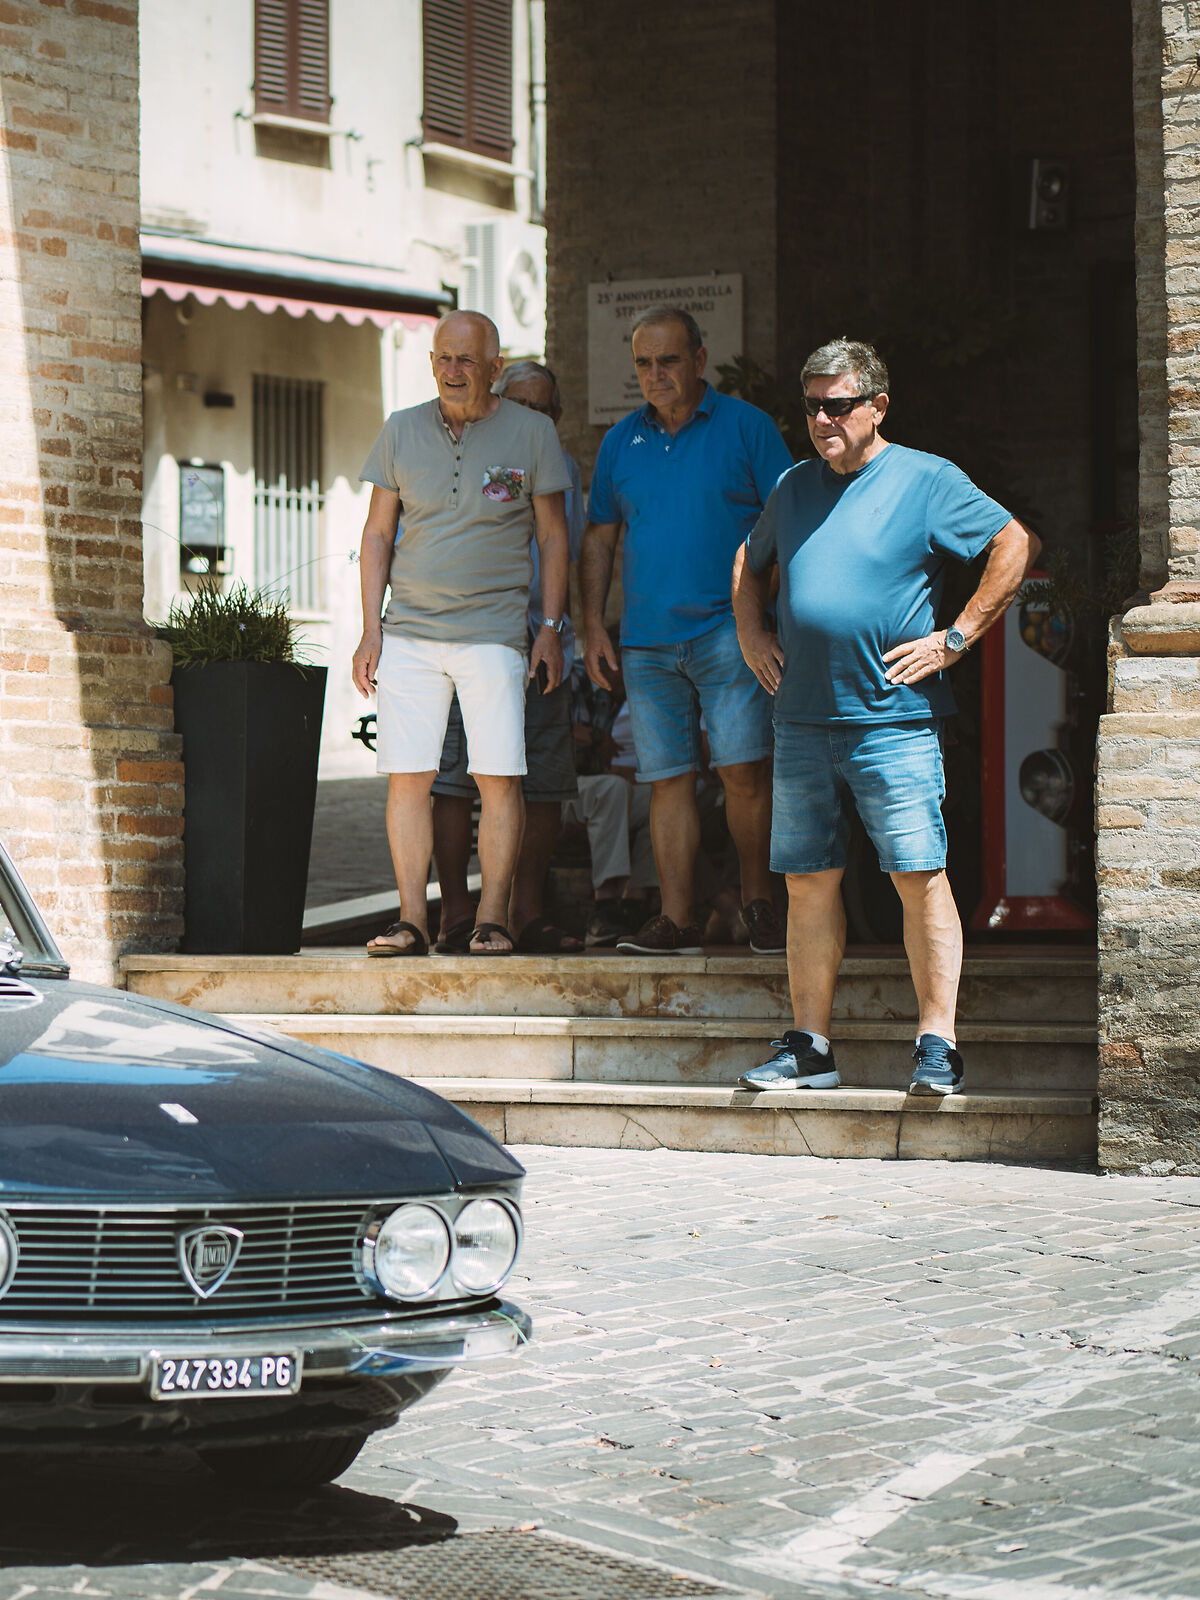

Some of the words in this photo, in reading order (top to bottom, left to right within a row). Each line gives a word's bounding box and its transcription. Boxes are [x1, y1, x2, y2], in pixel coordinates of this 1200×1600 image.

[616, 286, 695, 302] ANNIVERSARIO
[697, 285, 732, 297] DELLA
[161, 1359, 252, 1391] 247334
[260, 1356, 291, 1386] PG
